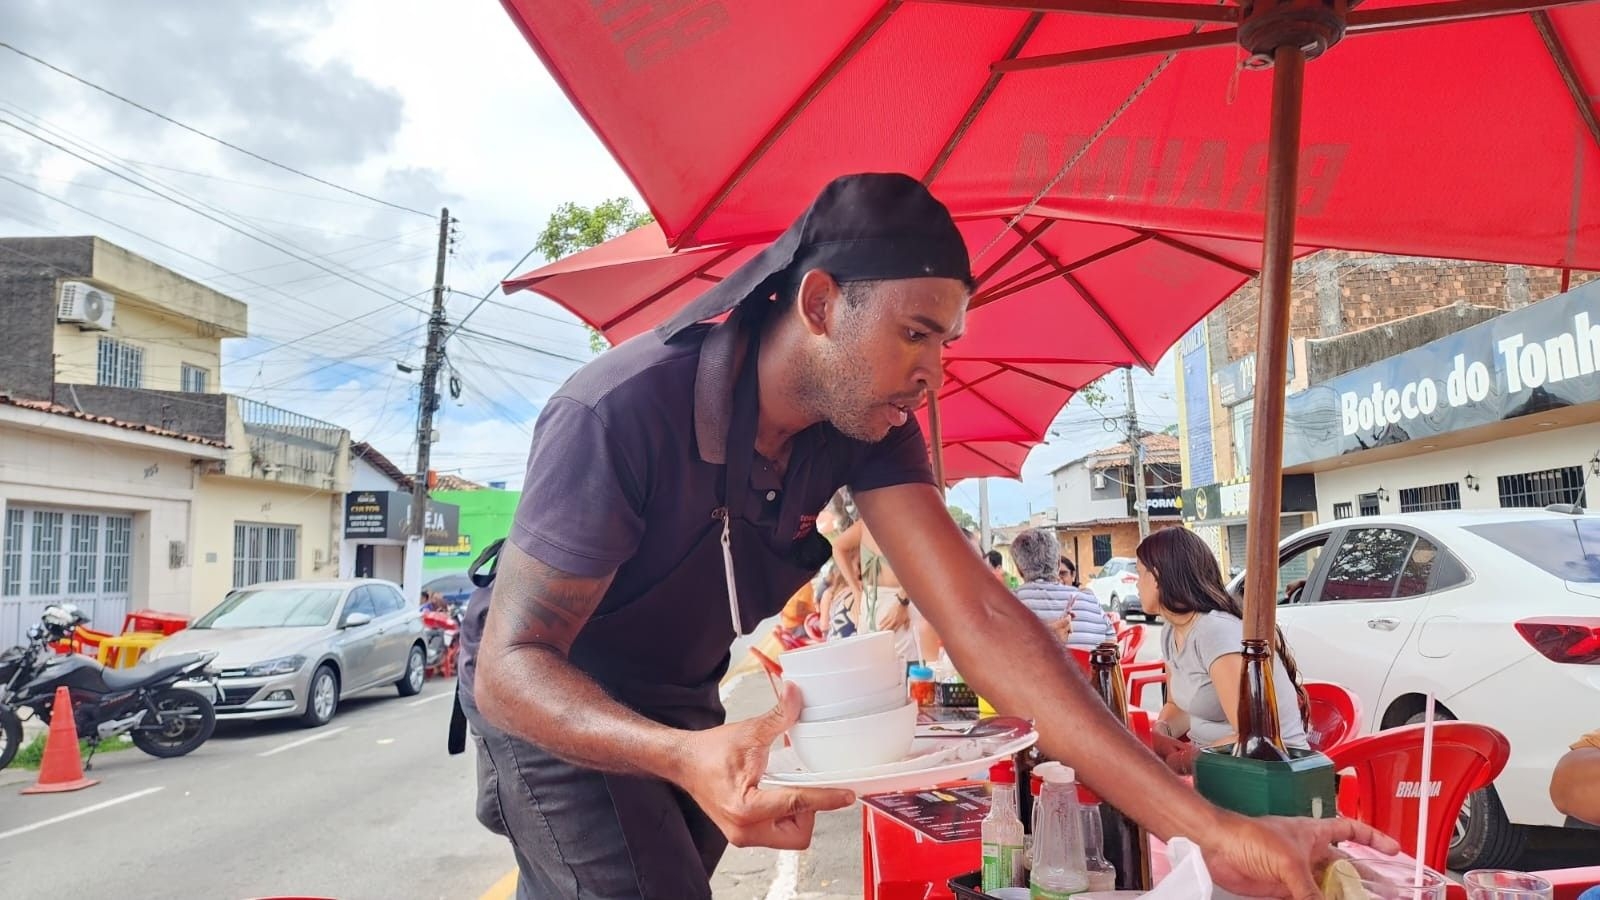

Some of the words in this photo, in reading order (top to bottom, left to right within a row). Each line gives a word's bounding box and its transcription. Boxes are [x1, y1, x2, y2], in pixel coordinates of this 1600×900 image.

[1341, 377, 1438, 436] Boteco
[1447, 353, 1490, 408] do
[1498, 311, 1600, 394] Tonh
[406, 504, 445, 531] IEJA
[1395, 780, 1442, 798] BRAMA
